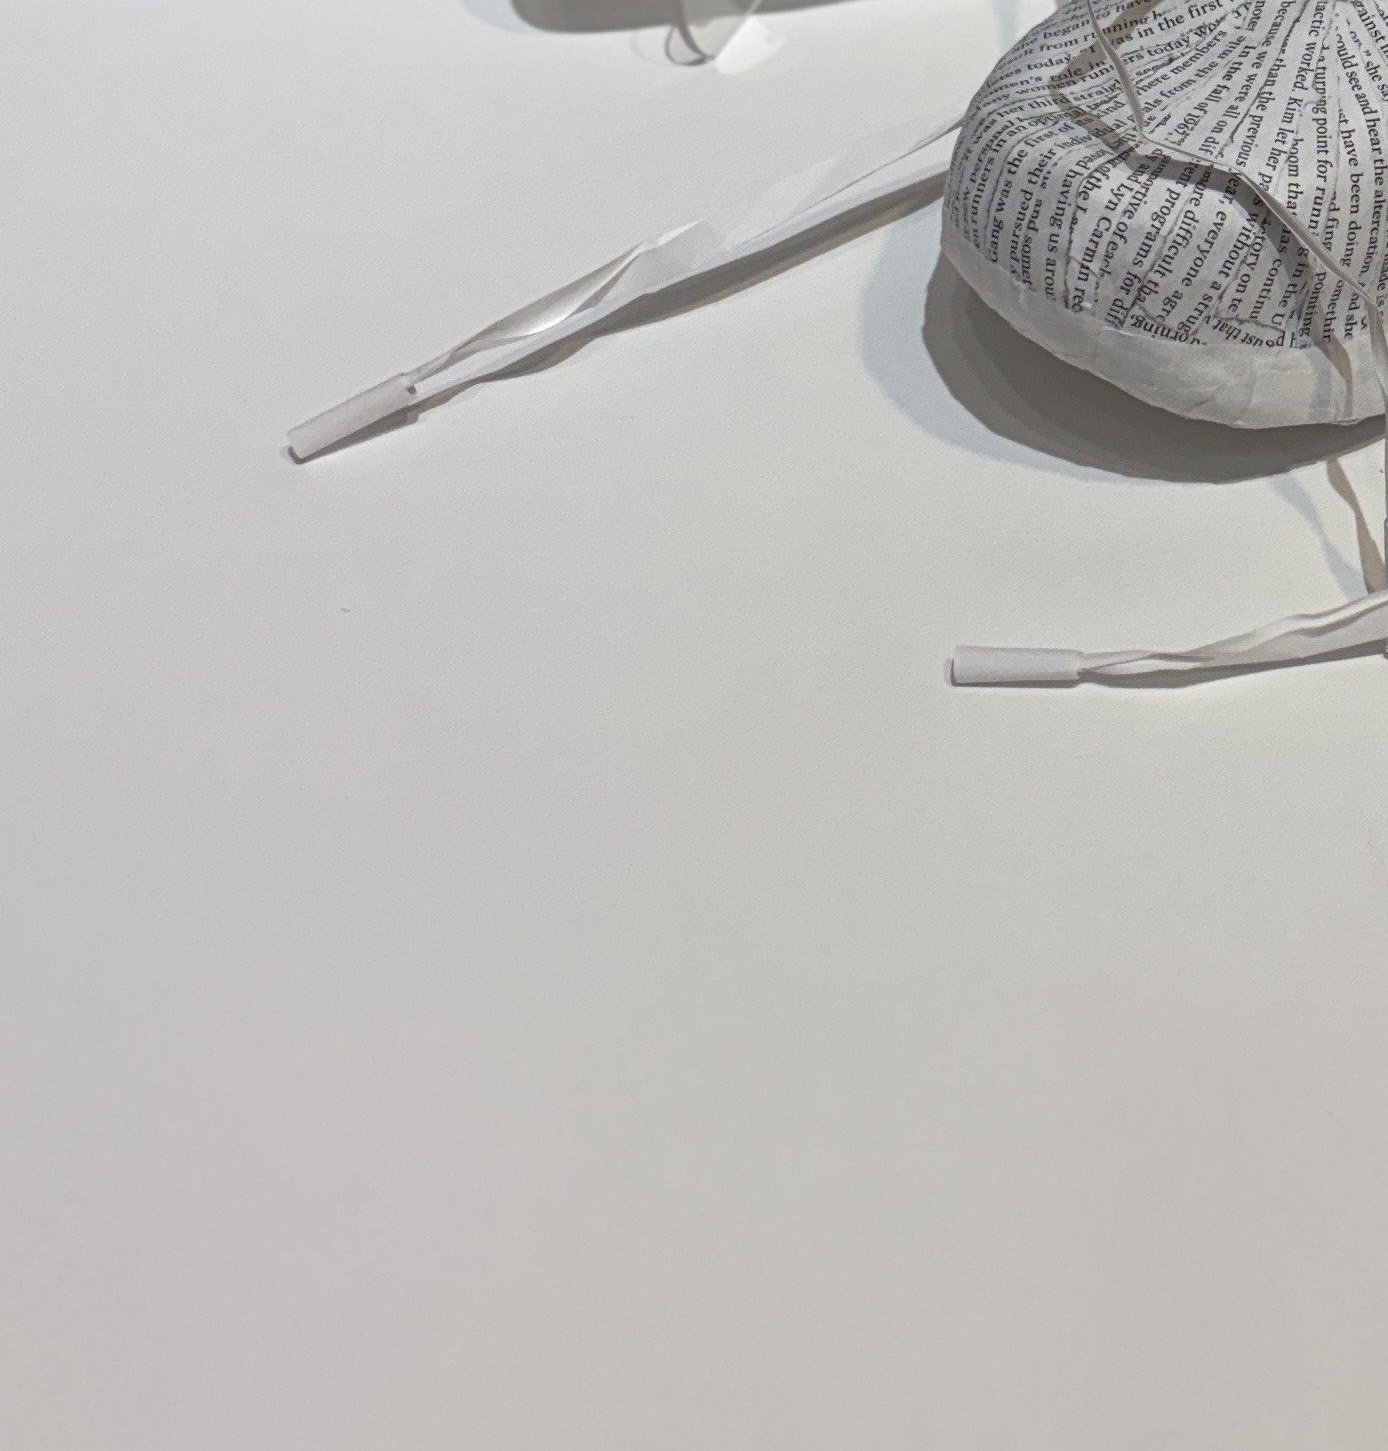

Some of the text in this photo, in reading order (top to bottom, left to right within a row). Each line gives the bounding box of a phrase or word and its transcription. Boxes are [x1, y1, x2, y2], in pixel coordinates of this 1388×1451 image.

[1162, 31, 1232, 74] members
[1223, 62, 1243, 81] the
[1238, 45, 1256, 57] In
[1365, 61, 1382, 82] she
[1205, 84, 1230, 102] fall
[1223, 74, 1261, 118] were all
[1238, 58, 1286, 167] than previous
[1266, 42, 1322, 171] worked. Kim let her
[1312, 118, 1332, 155] point
[1050, 169, 1078, 229] having
[1105, 183, 1131, 216] Lyn
[1340, 129, 1363, 267] have been doing
[1346, 71, 1388, 278] see and hear altercation.
[1120, 185, 1180, 295] programs for
[1154, 206, 1199, 284] difficult
[1182, 211, 1226, 290] everyone
[1218, 210, 1260, 283] without
